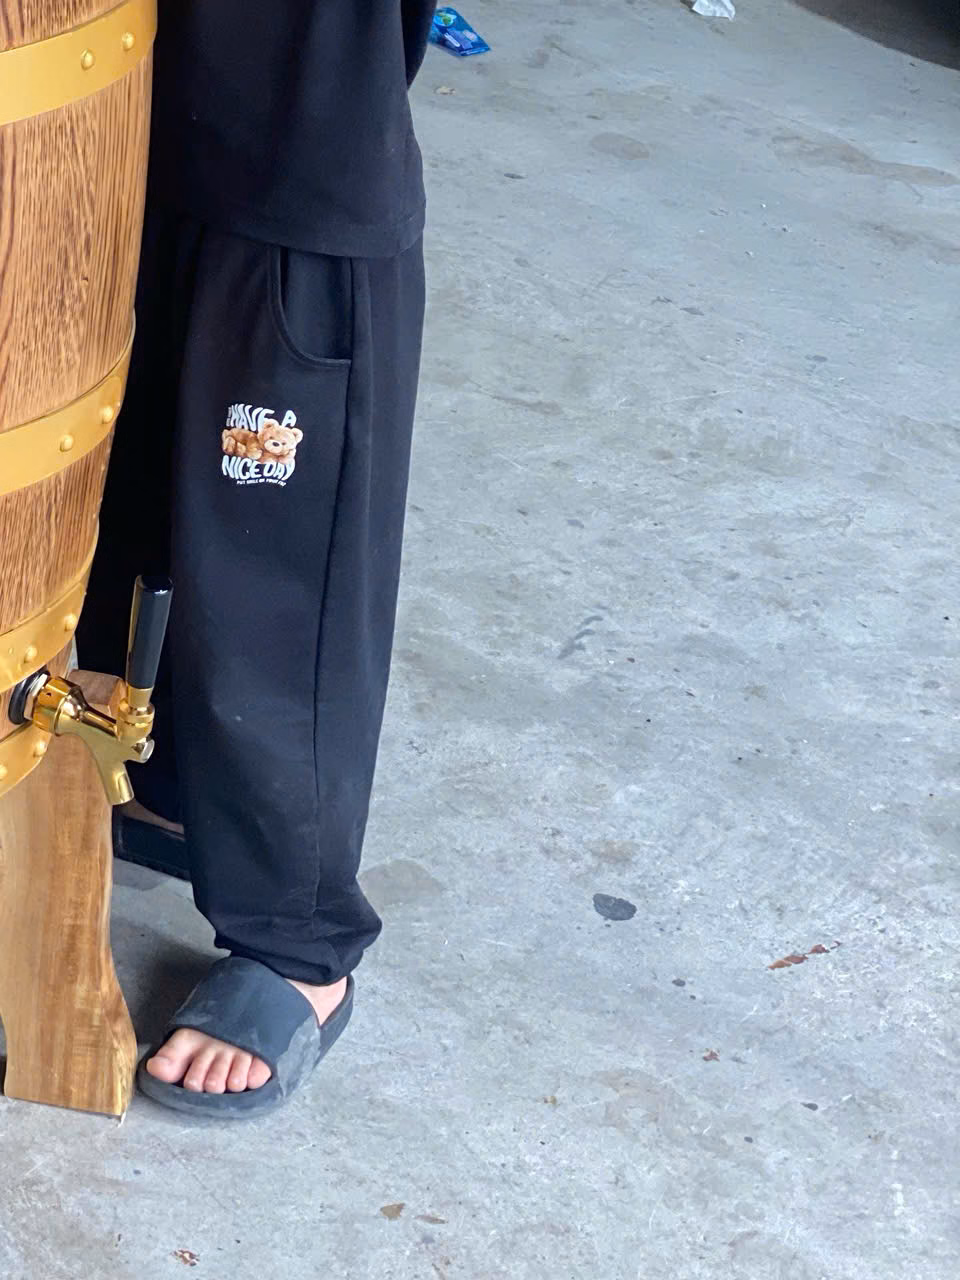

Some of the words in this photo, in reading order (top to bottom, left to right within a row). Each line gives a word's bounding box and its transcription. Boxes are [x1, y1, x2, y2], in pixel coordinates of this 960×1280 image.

[281, 409, 297, 428] A
[221, 455, 262, 480] NICE
[263, 458, 296, 481] DAY
